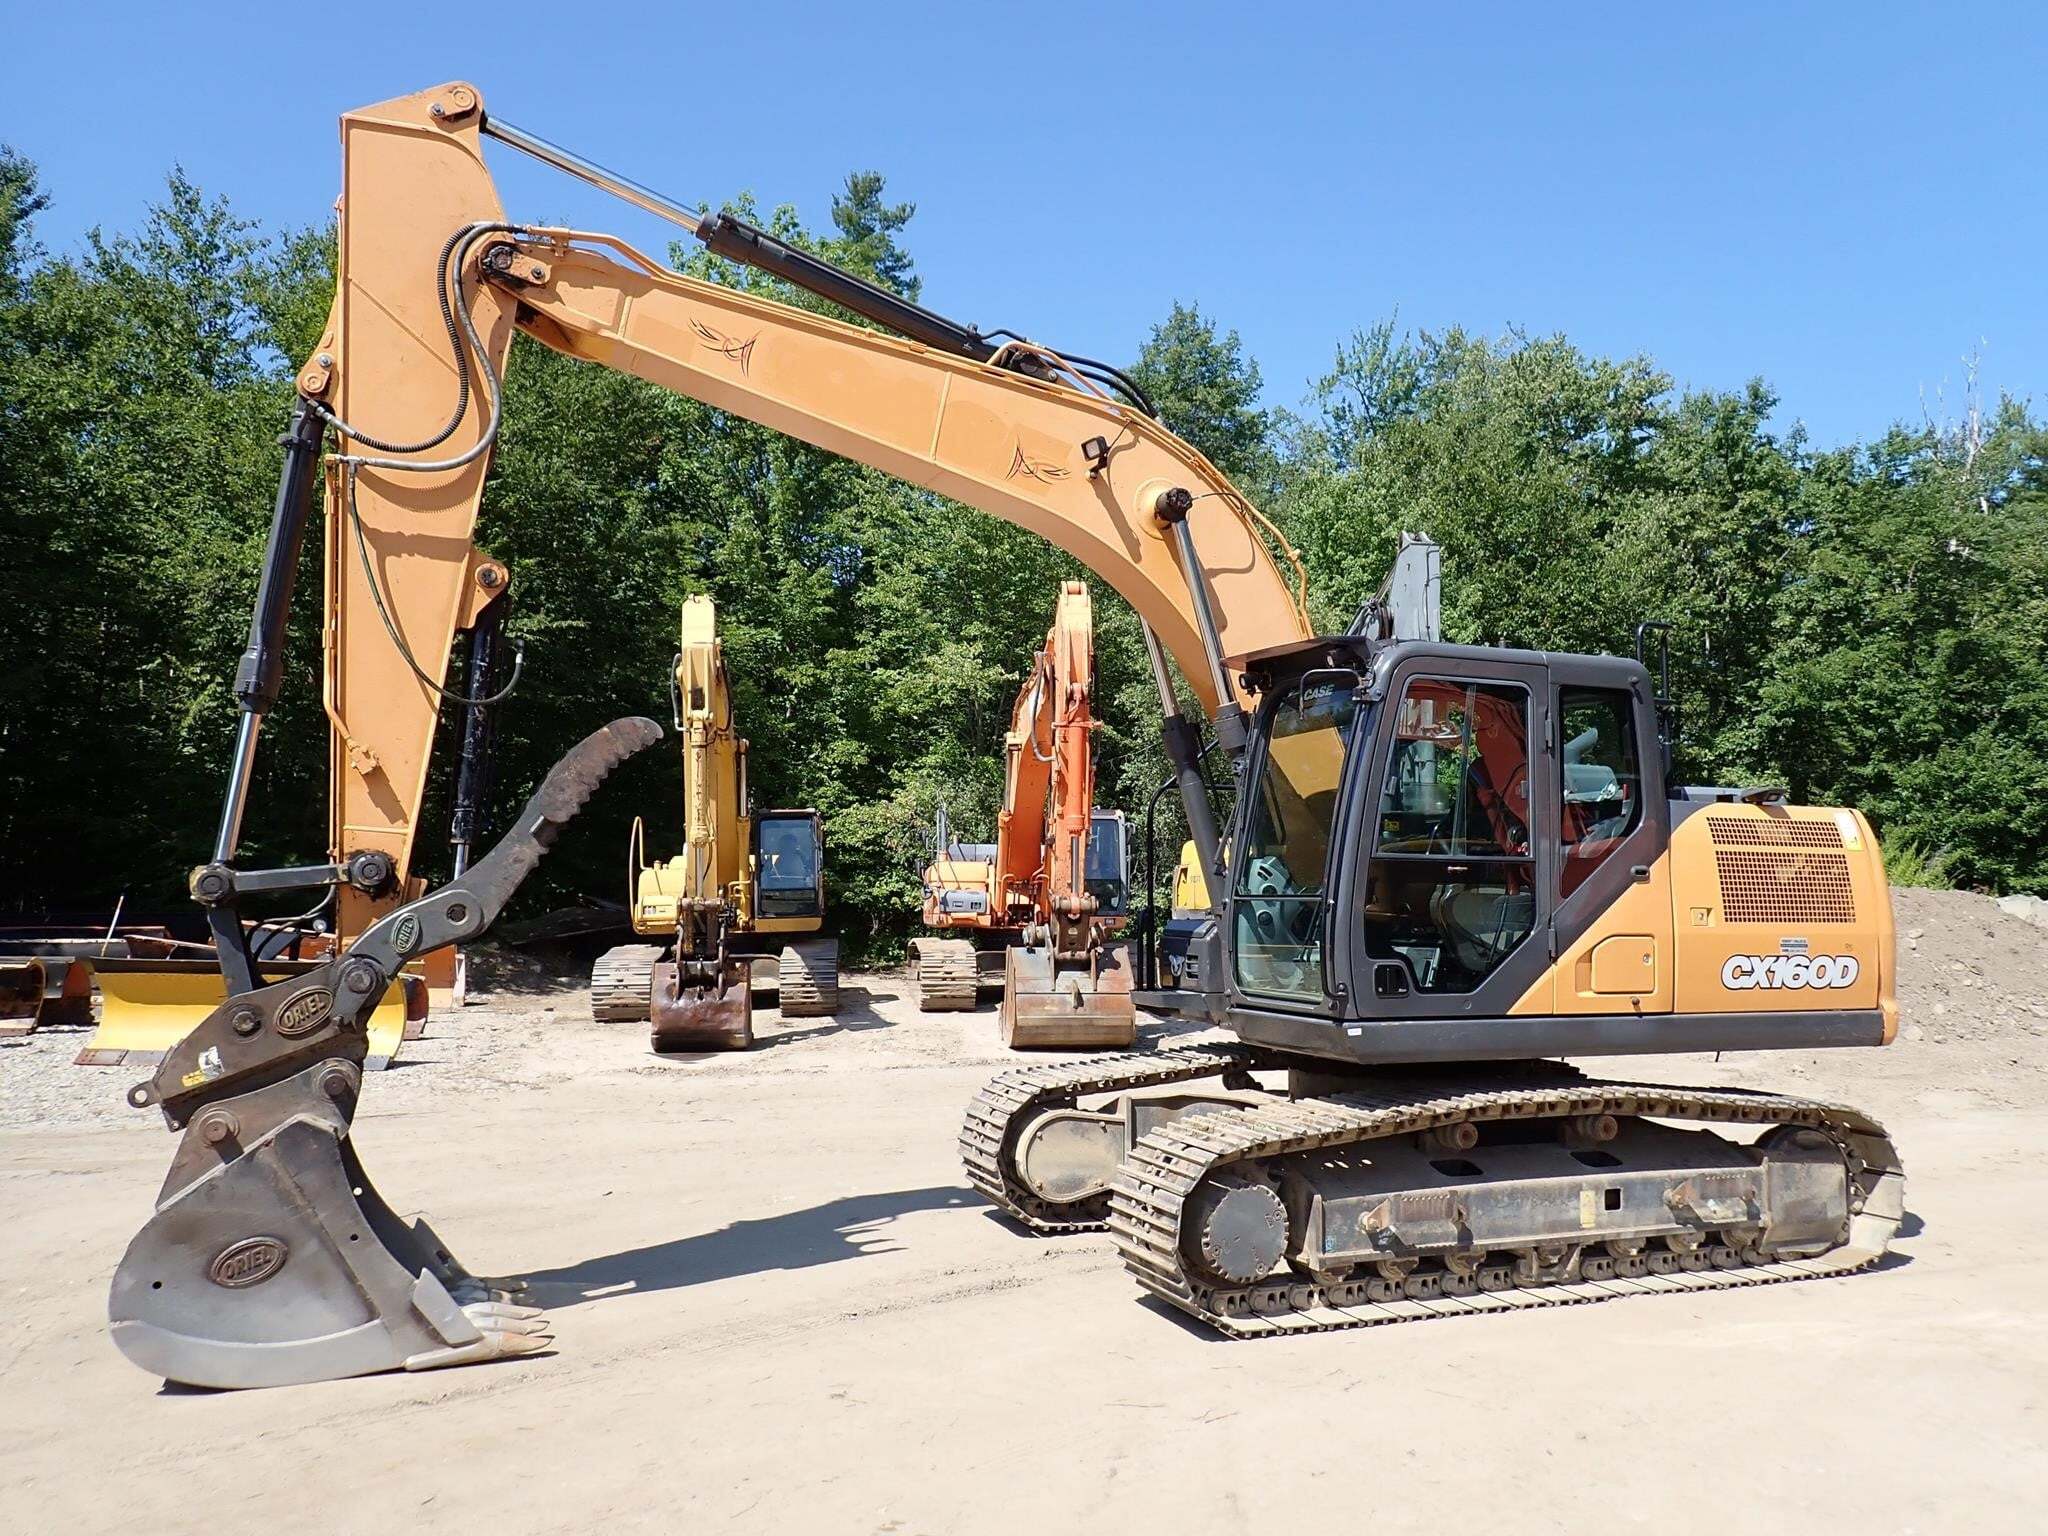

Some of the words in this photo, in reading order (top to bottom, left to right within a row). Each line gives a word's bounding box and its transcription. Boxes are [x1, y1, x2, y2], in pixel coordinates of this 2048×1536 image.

[1304, 684, 1335, 700] CASE
[1721, 954, 1859, 990] CX160D
[284, 993, 326, 1027] ORIEL
[220, 1246, 272, 1279] ORIEL
